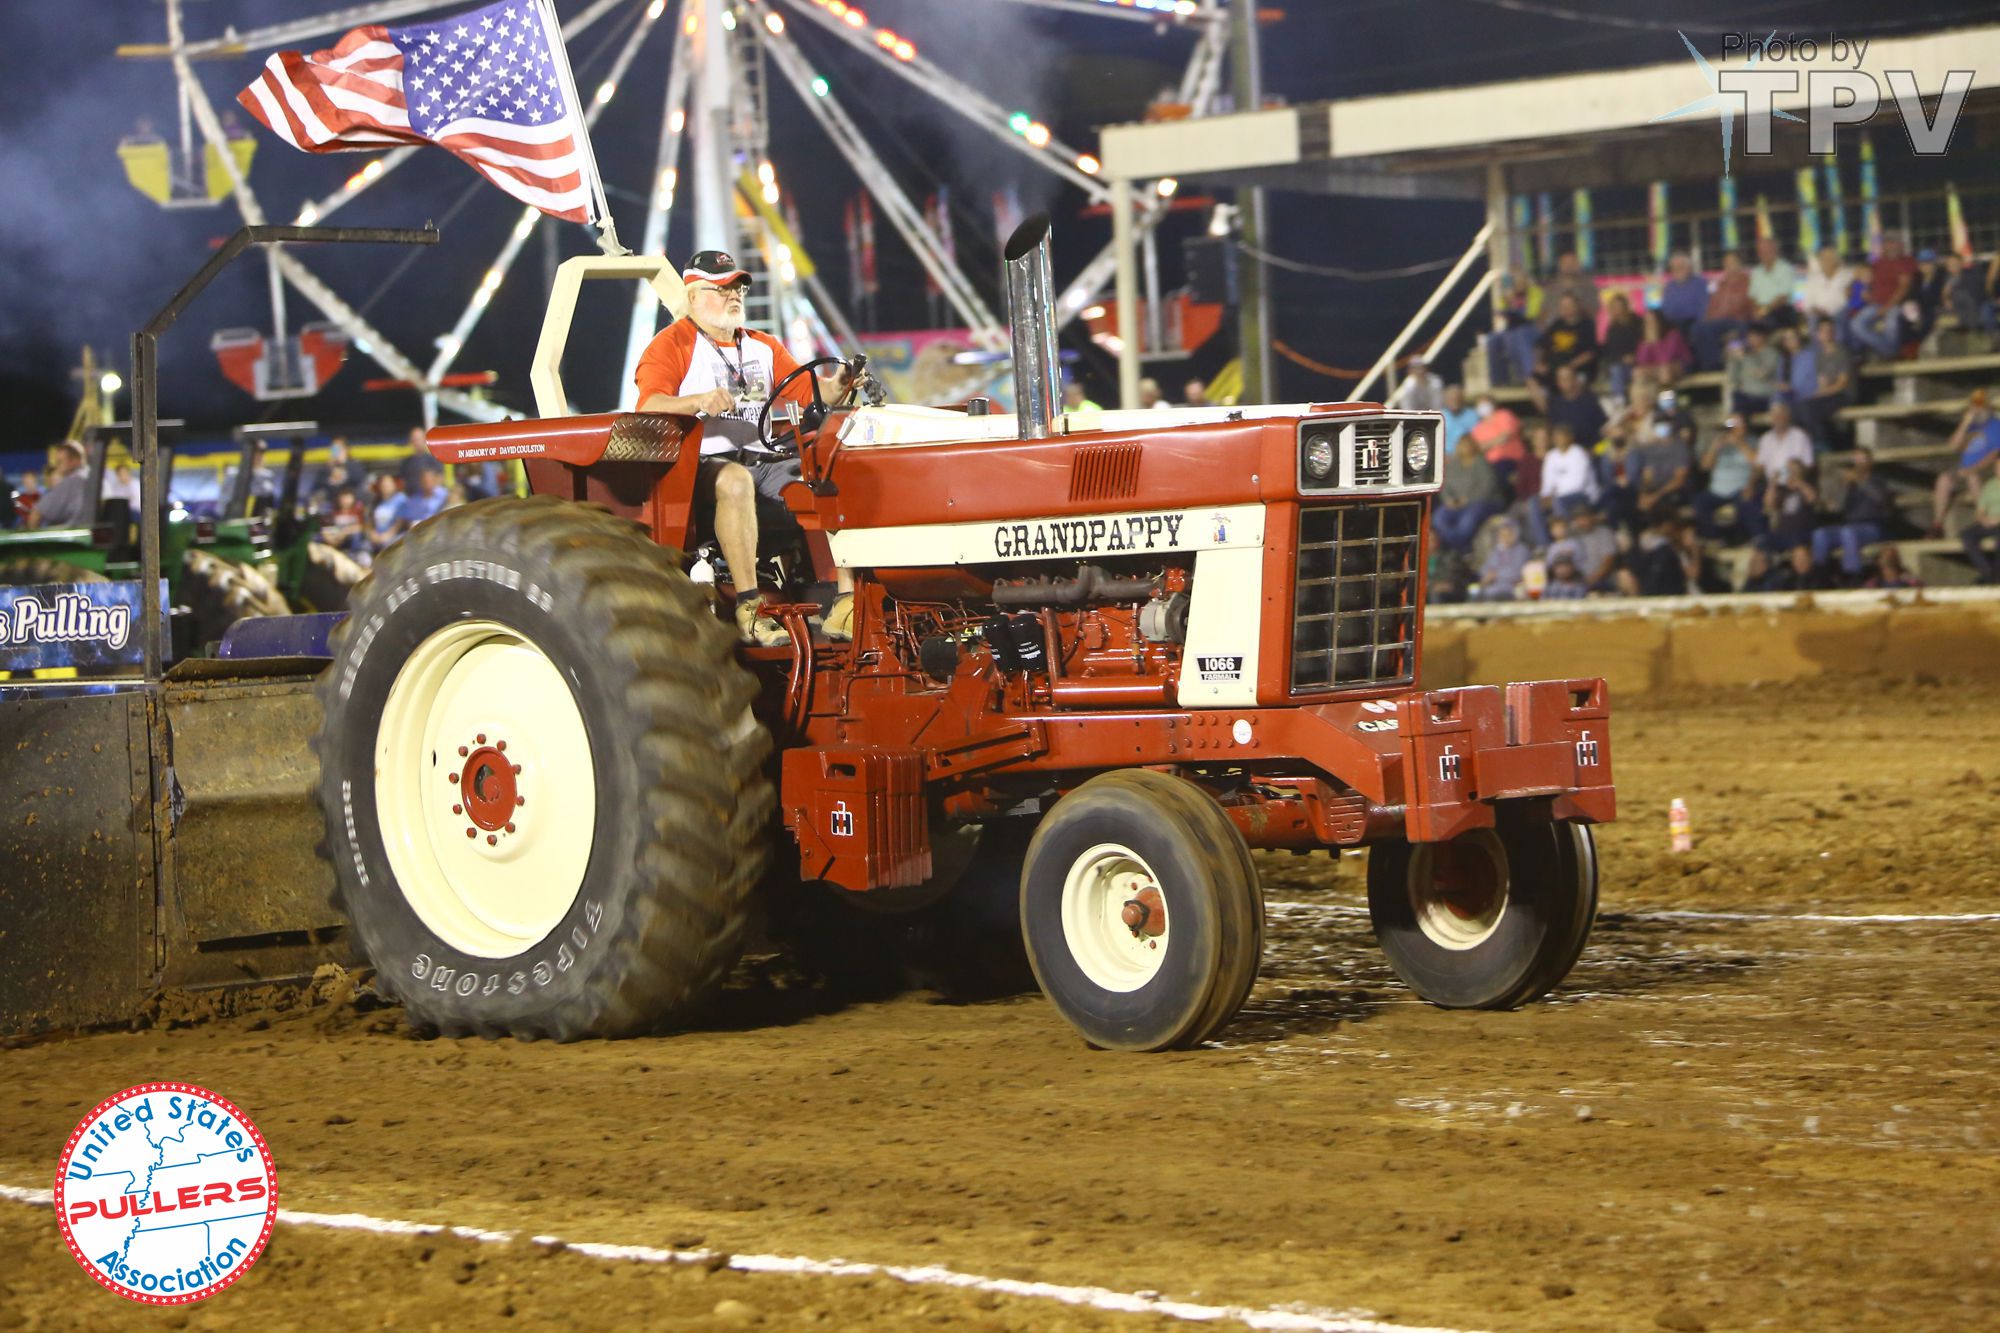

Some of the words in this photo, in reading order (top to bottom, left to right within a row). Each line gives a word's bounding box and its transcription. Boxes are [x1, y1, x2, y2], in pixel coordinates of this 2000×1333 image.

[458, 449, 465, 458] IN
[465, 448, 488, 457] MEMORY
[489, 447, 496, 456] OF
[499, 445, 516, 455] DAVID
[516, 443, 545, 454] COULSTON
[994, 514, 1184, 558] GRANDPAPPY
[12, 593, 131, 650] Pulling
[1205, 657, 1235, 671] 1066
